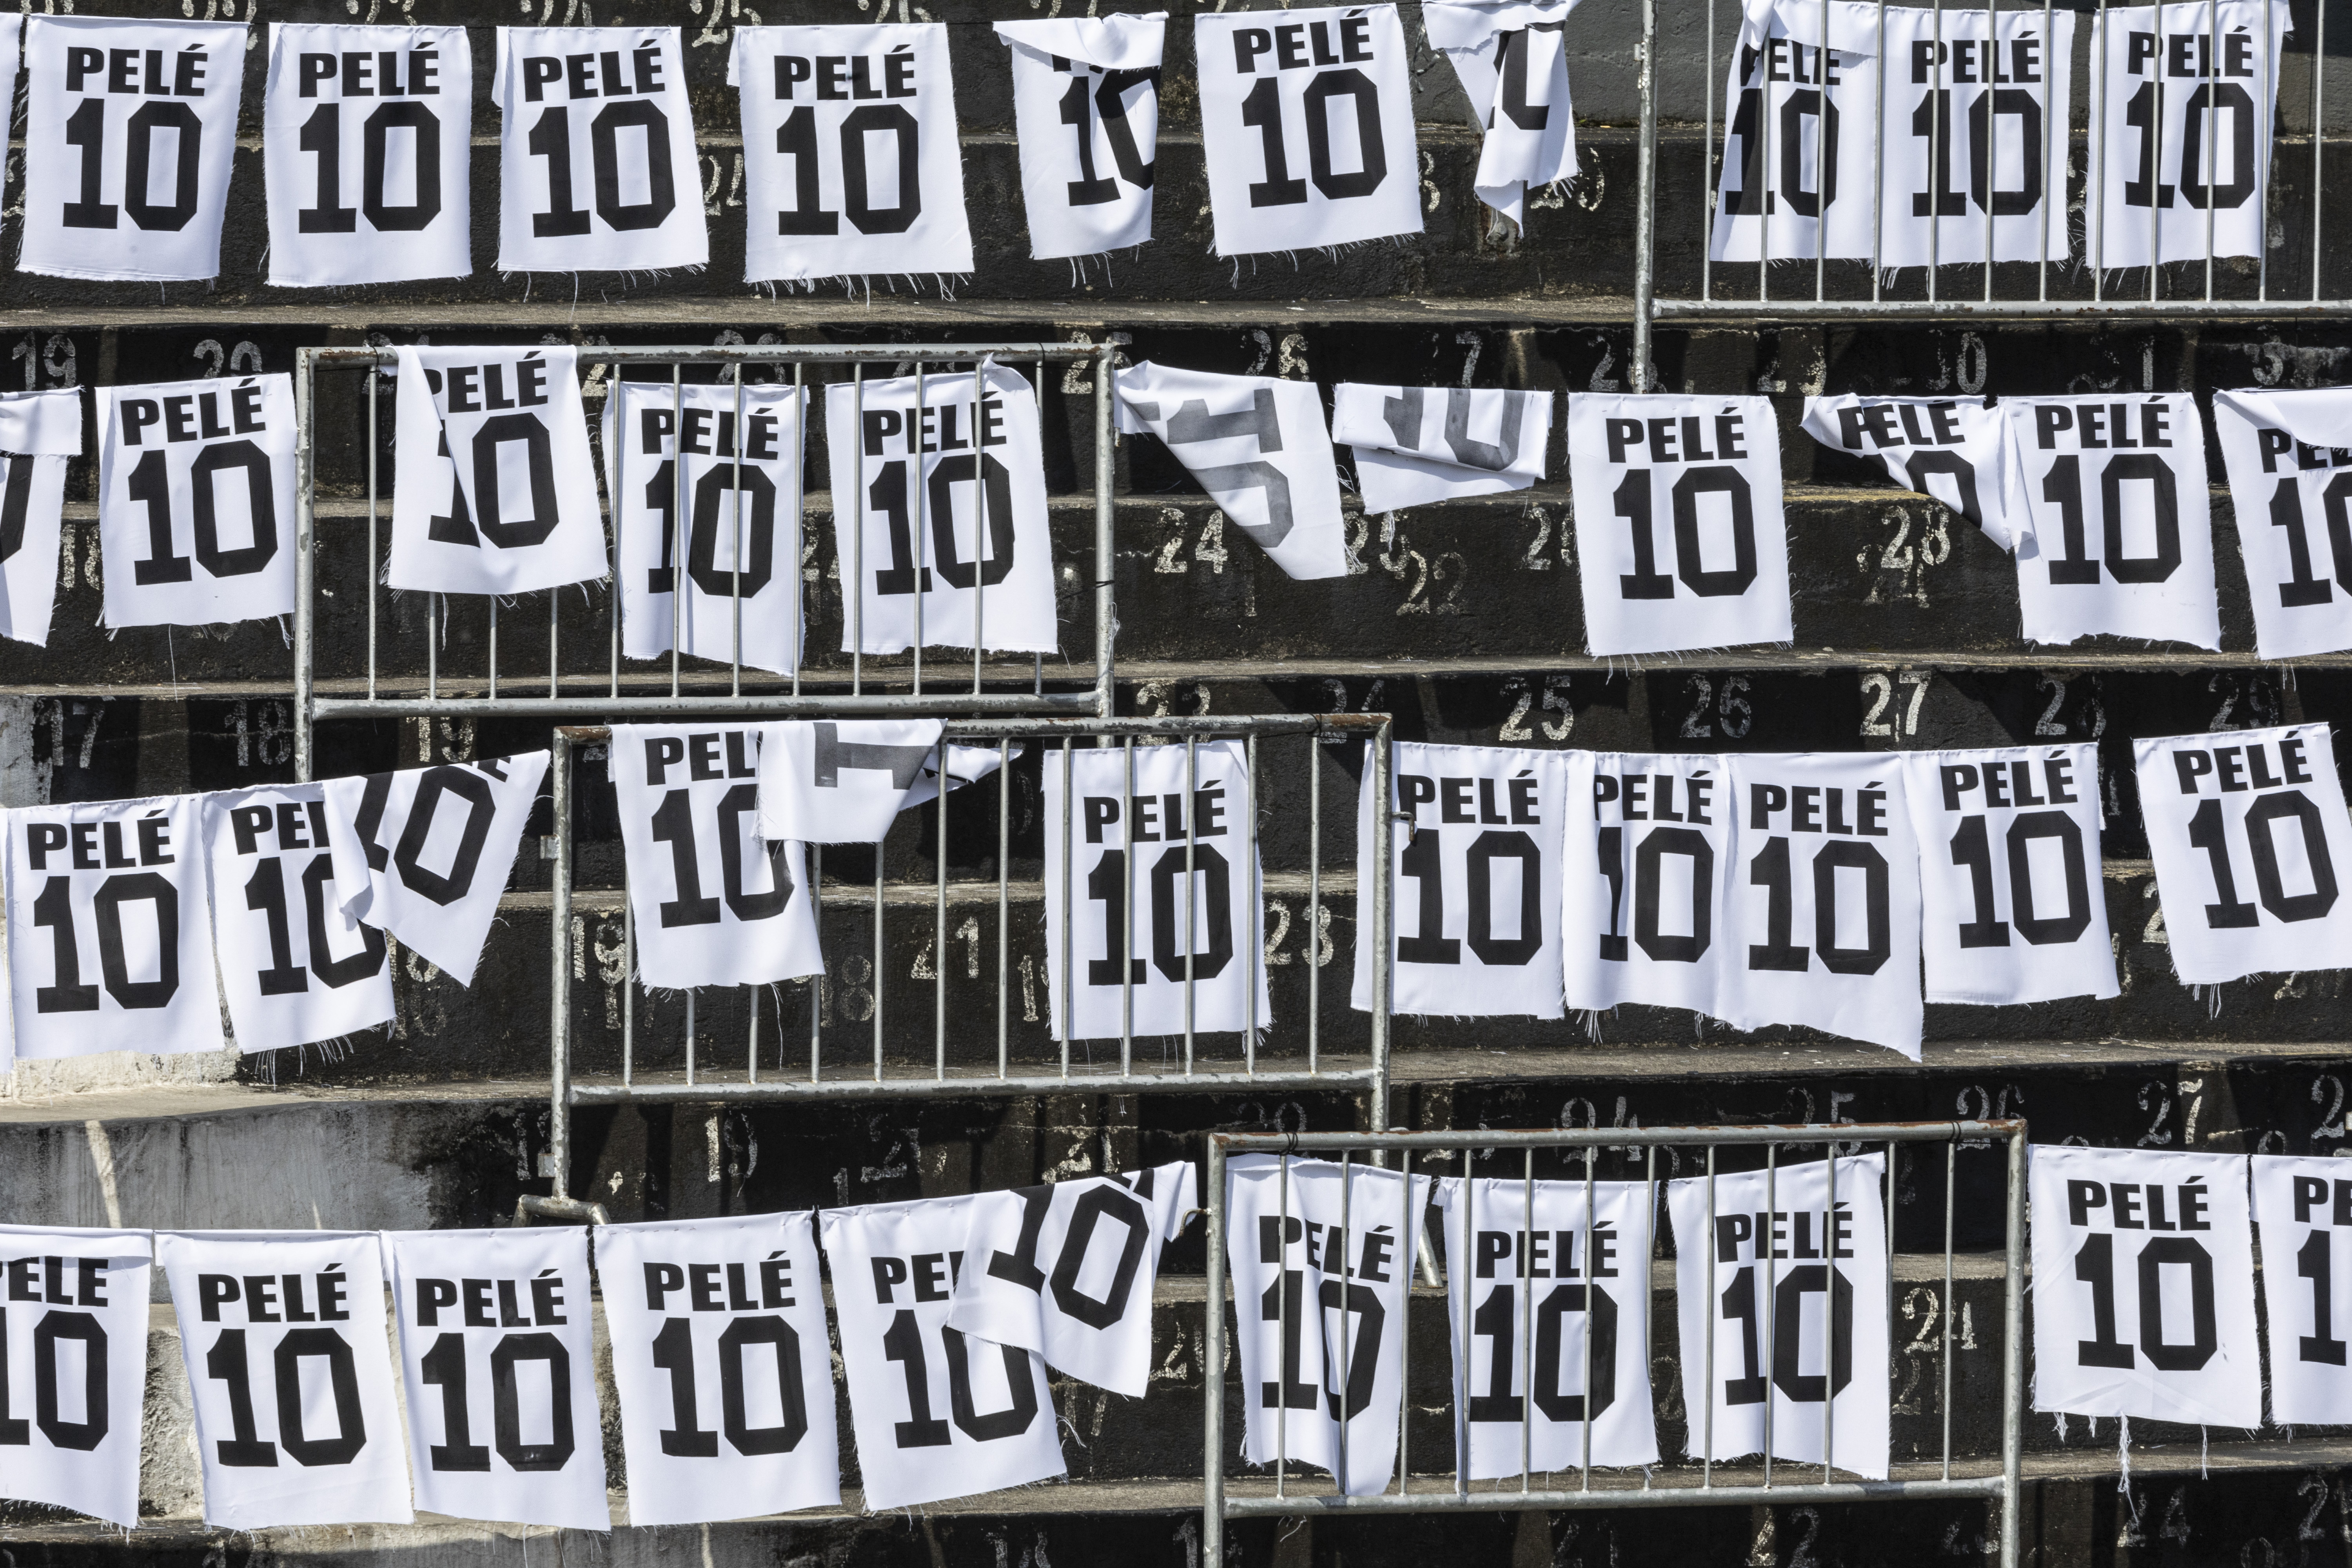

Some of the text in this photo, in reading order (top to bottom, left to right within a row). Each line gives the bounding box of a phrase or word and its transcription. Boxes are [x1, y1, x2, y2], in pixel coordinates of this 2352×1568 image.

[66, 44, 209, 97] PELÉ
[299, 42, 440, 98] PELÉ
[522, 39, 665, 102] PELÉ
[774, 45, 917, 100] PELÉ
[1232, 9, 1374, 74] PELÉ
[1911, 31, 2041, 83] PELÉ
[2128, 25, 2254, 77] PELÉ
[63, 98, 202, 232] 10
[298, 101, 441, 233] 10
[528, 99, 675, 238] 10
[777, 104, 921, 235] 10
[1241, 68, 1387, 208] 10
[1725, 88, 1840, 218] 10
[1913, 89, 2042, 217] 10
[2125, 81, 2255, 209] 10
[12, 330, 76, 392] 19
[120, 377, 266, 446] PELÉ
[641, 399, 778, 460] PELÉ
[862, 391, 1007, 456] PELÉ
[1606, 407, 1748, 463] PELÉ
[2034, 395, 2173, 450] PELÉ
[128, 439, 278, 586] 10
[646, 460, 777, 598] 10
[869, 452, 1014, 595] 10
[1154, 508, 1228, 573] 24
[1613, 465, 1757, 599] 10
[2042, 454, 2181, 584] 10
[39, 700, 105, 769] 17
[225, 700, 291, 766] 18
[1499, 675, 1573, 740] 25
[1680, 674, 1751, 738] 26
[1860, 671, 1931, 736] 27
[644, 731, 756, 785] PEL
[1940, 750, 2078, 811] PELÉ
[2172, 730, 2313, 794] PELÉ
[1084, 779, 1227, 843] PELÉ
[1397, 769, 1540, 824] PELÉ
[1594, 770, 1713, 826] PELÉ
[1750, 781, 1888, 836] PELÉ
[27, 809, 175, 870] PELÉ
[652, 784, 795, 928] 10
[2188, 789, 2339, 929] 10
[1397, 828, 1542, 965] 10
[1598, 826, 1714, 964] 10
[1749, 836, 1890, 975] 10
[1949, 810, 2091, 949] 10
[34, 872, 179, 1013] 10
[245, 853, 387, 996] 10
[1088, 843, 1233, 985] 10
[1263, 899, 1334, 967] 23
[2138, 1078, 2203, 1147] 27
[1715, 1201, 1854, 1263] PELÉ
[2067, 1176, 2211, 1231] PELÉ
[643, 1250, 796, 1311] PELÉ
[1259, 1215, 1395, 1283] PELÉ
[1476, 1221, 1619, 1279] PELÉ
[198, 1263, 350, 1323] PELÉ
[416, 1269, 567, 1327] PELÉ
[2074, 1232, 2218, 1371] 10
[1261, 1269, 1386, 1423] 10
[1469, 1284, 1618, 1423] 10
[1721, 1265, 1853, 1406] 10
[207, 1328, 367, 1467] 10
[421, 1332, 575, 1472] 10
[652, 1314, 808, 1457] 10
[883, 1309, 1038, 1449] 10
